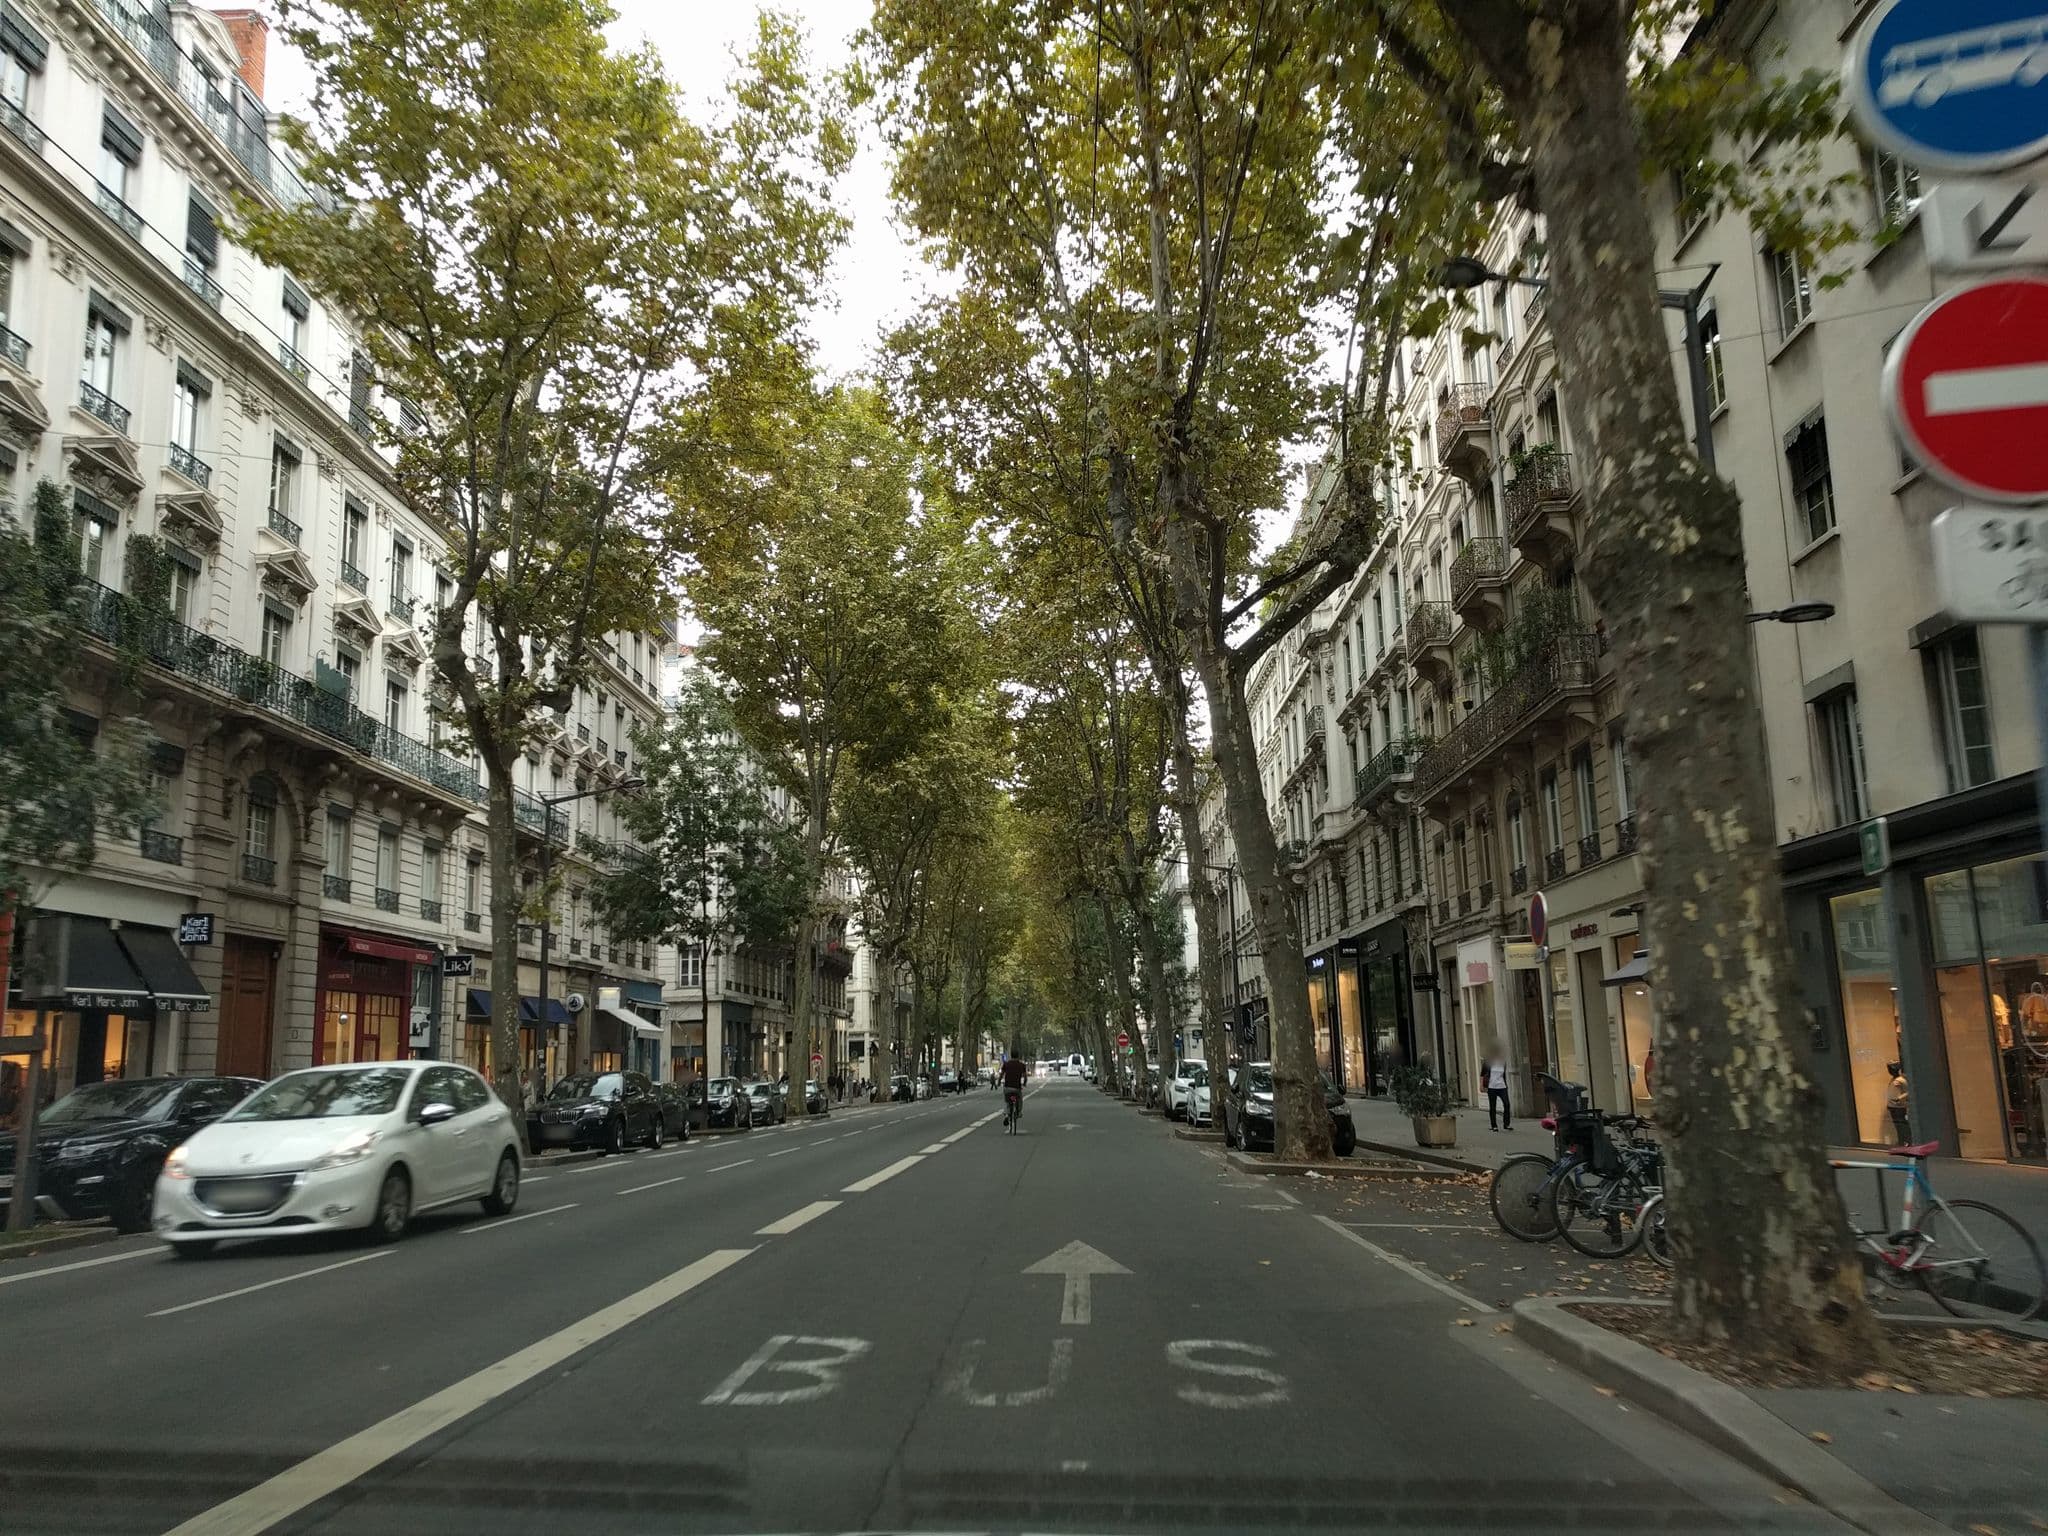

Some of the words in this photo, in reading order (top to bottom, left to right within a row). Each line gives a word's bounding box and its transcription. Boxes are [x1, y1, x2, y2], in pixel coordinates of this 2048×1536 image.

[186, 916, 209, 927] Karl
[181, 926, 209, 934] Marc
[180, 933, 209, 942] John
[72, 994, 92, 1007] Karl
[96, 996, 116, 1008] Marc
[120, 997, 139, 1008] John
[700, 1334, 1291, 1409] BUS
